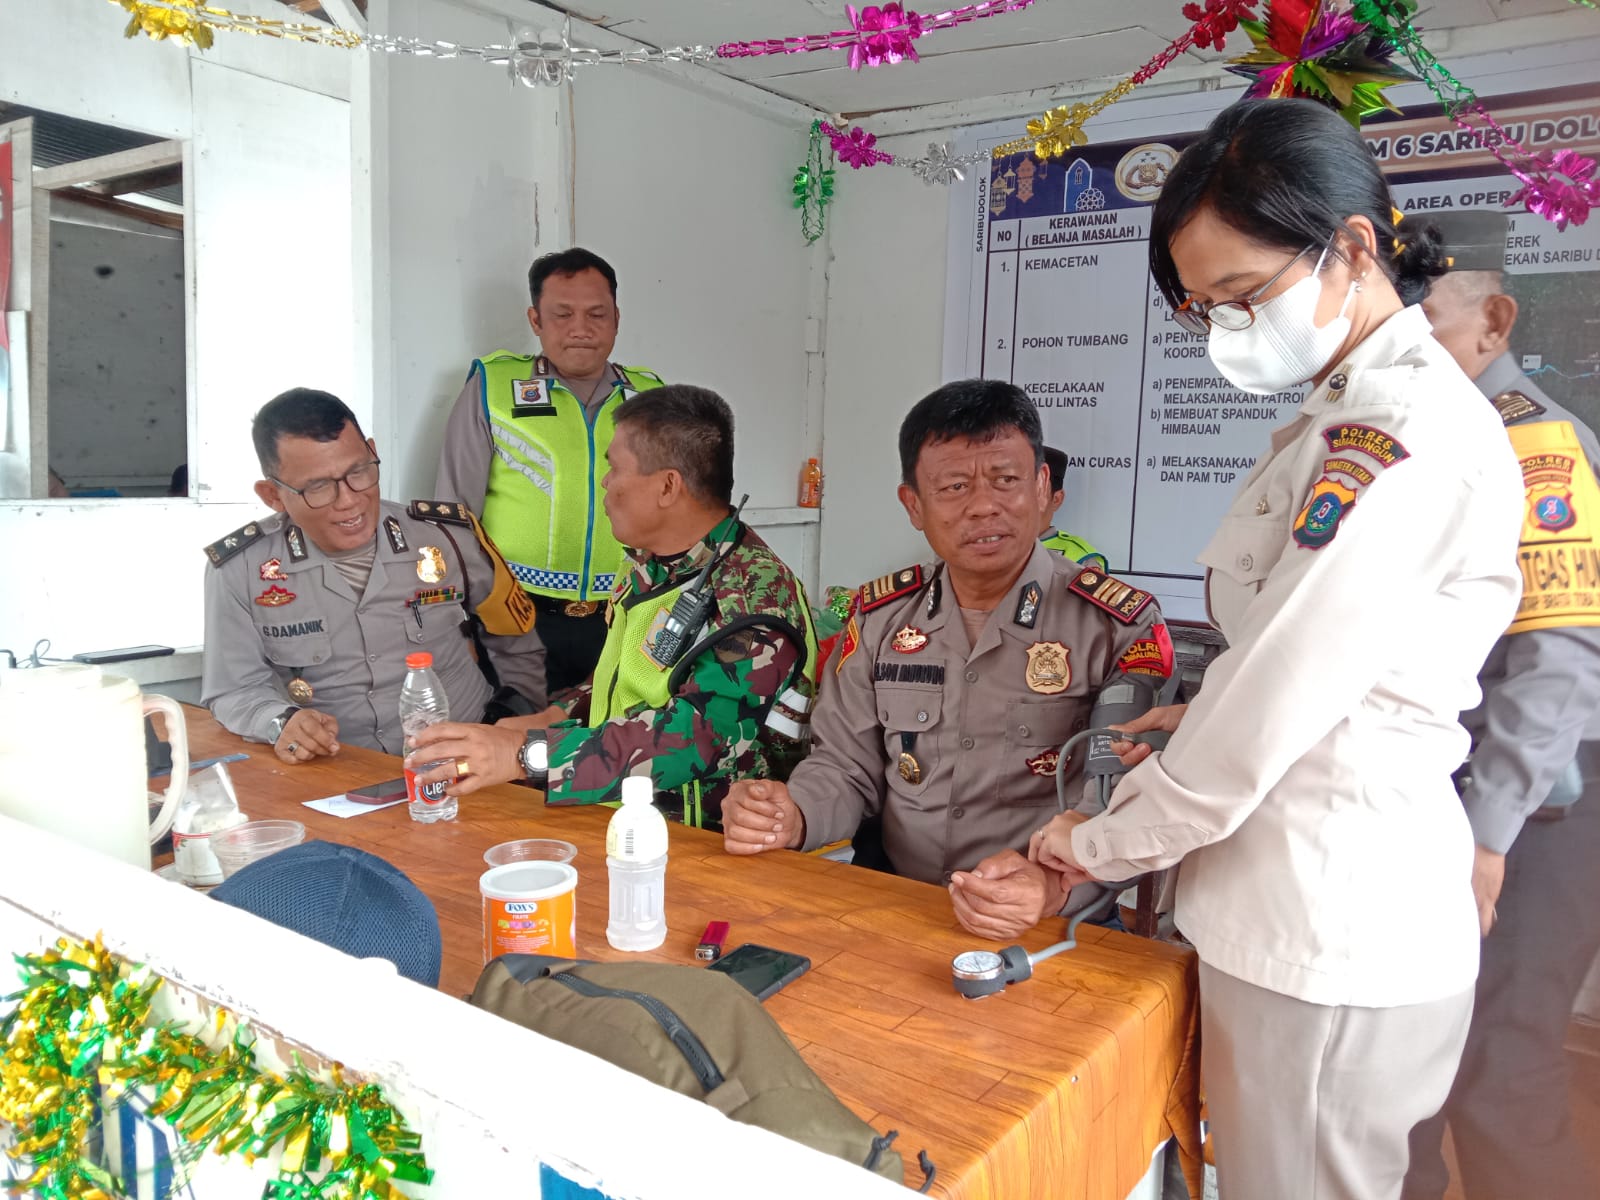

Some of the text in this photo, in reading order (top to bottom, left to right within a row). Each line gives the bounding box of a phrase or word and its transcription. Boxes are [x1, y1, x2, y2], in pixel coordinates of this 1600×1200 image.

[1367, 115, 1600, 158] M 6 SARIBU DOL
[1403, 190, 1522, 211] AREA OPER
[976, 176, 987, 253] SARIBUDOLOK
[1049, 212, 1118, 229] KERAWANAN
[997, 230, 1012, 242] NO
[1032, 231, 1079, 246] BELANJA
[1082, 226, 1135, 241] MASALAH
[1506, 235, 1541, 249] EREK
[1025, 254, 1098, 270] KEMACETAN
[1504, 252, 1540, 266] EKAN
[1543, 249, 1592, 264] SARIBU
[1001, 261, 1010, 273] 1.
[997, 338, 1007, 350] 2.
[1022, 333, 1129, 349] POHON TUMBANG
[1152, 332, 1210, 346] a) PENYEL
[1164, 346, 1206, 359] KOORD
[1024, 381, 1105, 394] KECELAKAAN
[1152, 376, 1234, 392] a) PENEMPATA
[1030, 396, 1097, 408] ALU LINTAS
[1163, 391, 1258, 404] MELAKSANAKAN
[1150, 408, 1278, 421] b) MEMBUAT SPANDUK
[1161, 423, 1221, 435] HIMBAUAN
[1341, 427, 1393, 450] POLRES
[1068, 456, 1132, 469] AN CURAS
[1146, 455, 1257, 470] a) MELAKSANAKAN
[1160, 471, 1236, 483] DAN PAM TUP
